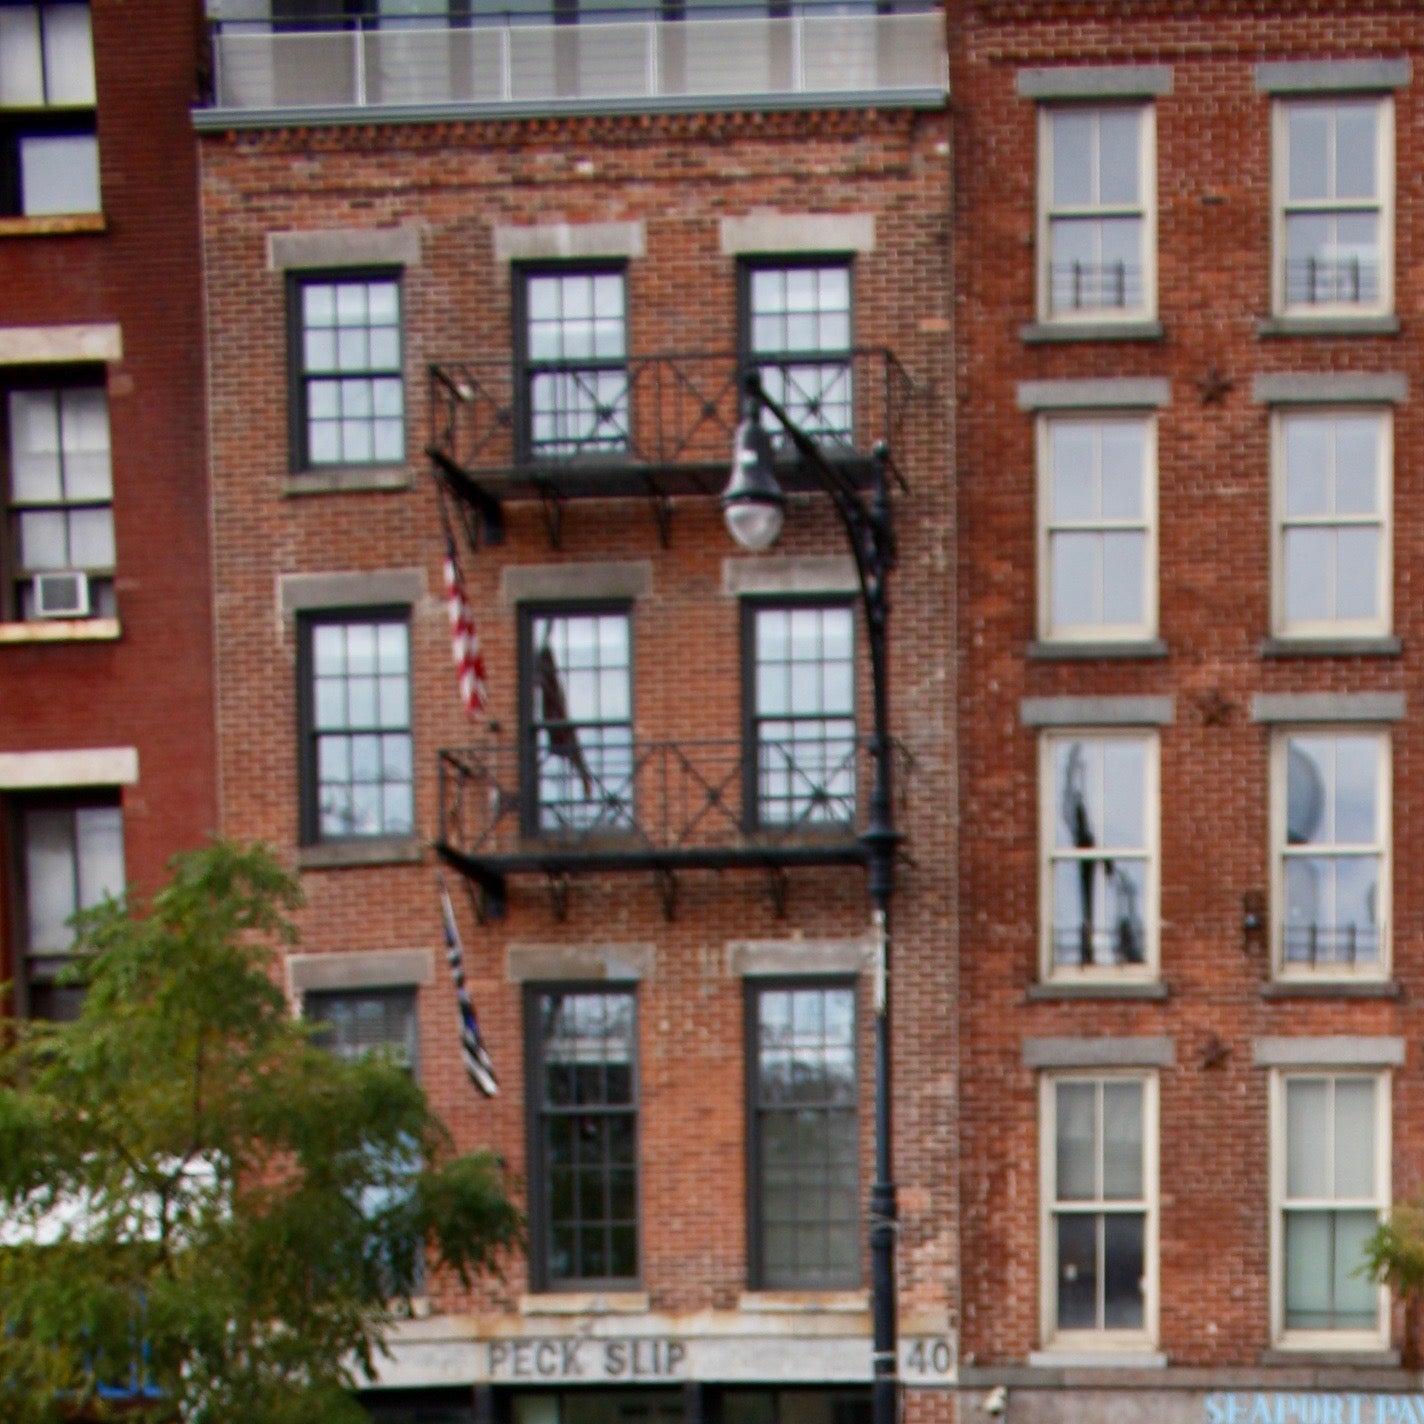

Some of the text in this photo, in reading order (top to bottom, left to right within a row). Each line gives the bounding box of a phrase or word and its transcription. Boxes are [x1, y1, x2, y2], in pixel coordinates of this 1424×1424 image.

[487, 1338, 687, 1376] PECK SLIP
[906, 1339, 950, 1374] 40
